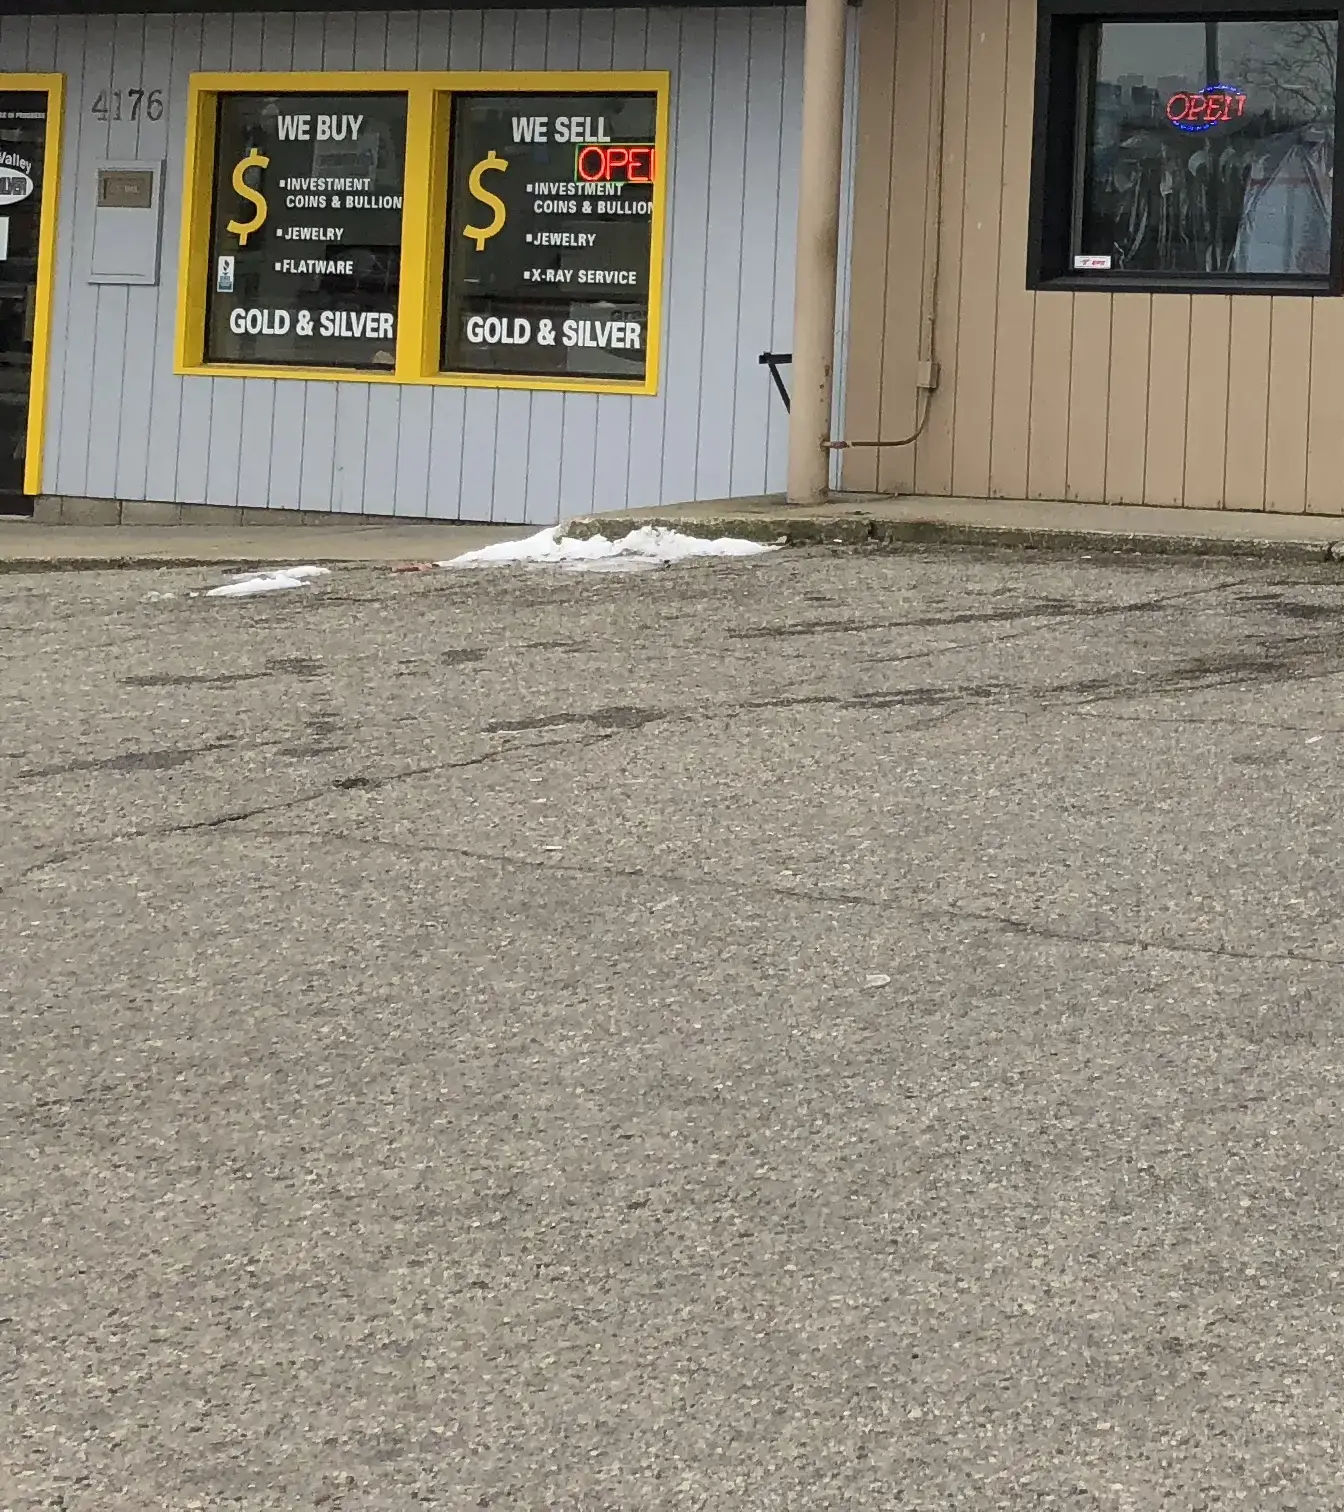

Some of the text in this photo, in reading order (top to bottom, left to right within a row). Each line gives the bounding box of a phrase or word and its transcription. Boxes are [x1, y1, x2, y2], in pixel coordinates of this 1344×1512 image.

[91, 88, 164, 122] 4176
[277, 114, 364, 141] WE BUY
[512, 116, 611, 143] WE SELL
[578, 146, 655, 181] OPE
[286, 177, 371, 191] INVESTMENT
[534, 182, 624, 196] INVESTMENT
[286, 195, 403, 209] COINS & BULLION
[534, 200, 577, 214] COINS
[581, 201, 593, 214] &
[284, 227, 344, 241] JEWELRY
[533, 232, 597, 247] JEWELRY
[283, 259, 354, 275] FLATWARE
[531, 269, 637, 285] X-RAY SERVICE
[229, 308, 393, 339] GOLD & SILVER
[467, 316, 641, 349] GOLD & SILVER
